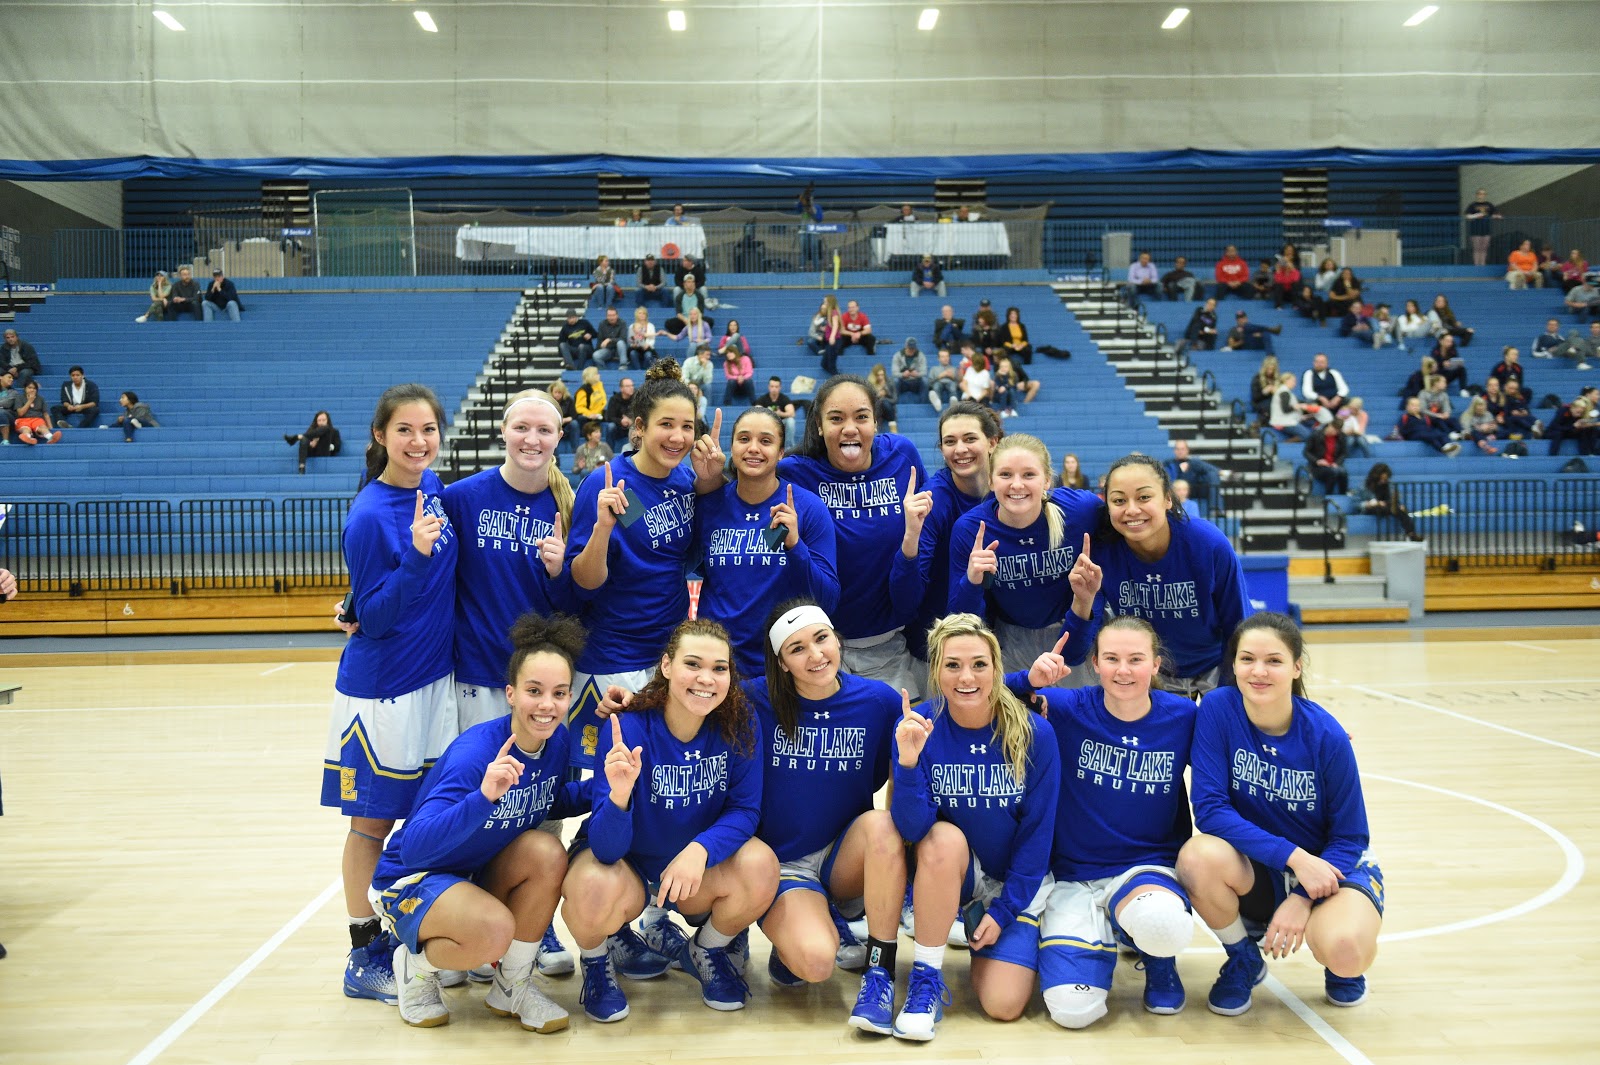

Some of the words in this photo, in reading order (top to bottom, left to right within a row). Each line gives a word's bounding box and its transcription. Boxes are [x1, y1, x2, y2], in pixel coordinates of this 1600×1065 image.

[818, 482, 858, 508] SALT
[859, 477, 900, 507] LAKE
[478, 508, 520, 540] SALT
[521, 517, 555, 547] LAK
[644, 500, 680, 539] SALT
[835, 505, 902, 520] RUINS
[652, 523, 692, 549] BRUI
[709, 528, 747, 556] SALT
[745, 528, 785, 555] LA
[709, 556, 787, 567] BRUINS
[996, 554, 1028, 582] ALT
[1030, 546, 1073, 578] LAKE
[1153, 581, 1198, 610] LAKE
[1119, 608, 1199, 619] BRUINS
[773, 724, 818, 757] SALT
[820, 727, 866, 758] LAKE
[652, 764, 692, 797] SALT
[692, 751, 728, 792] LAKE
[772, 756, 862, 771] BRUINS
[1079, 739, 1127, 777] SALT
[1126, 750, 1175, 782] LAKE
[650, 781, 727, 809] BRUINS
[931, 764, 975, 796] SALT
[1077, 769, 1171, 794] BRUINS
[1232, 779, 1315, 811] BRUNS
[1268, 765, 1317, 801] LAKE
[489, 787, 531, 820] SALT
[933, 795, 1023, 809] BRUINS
